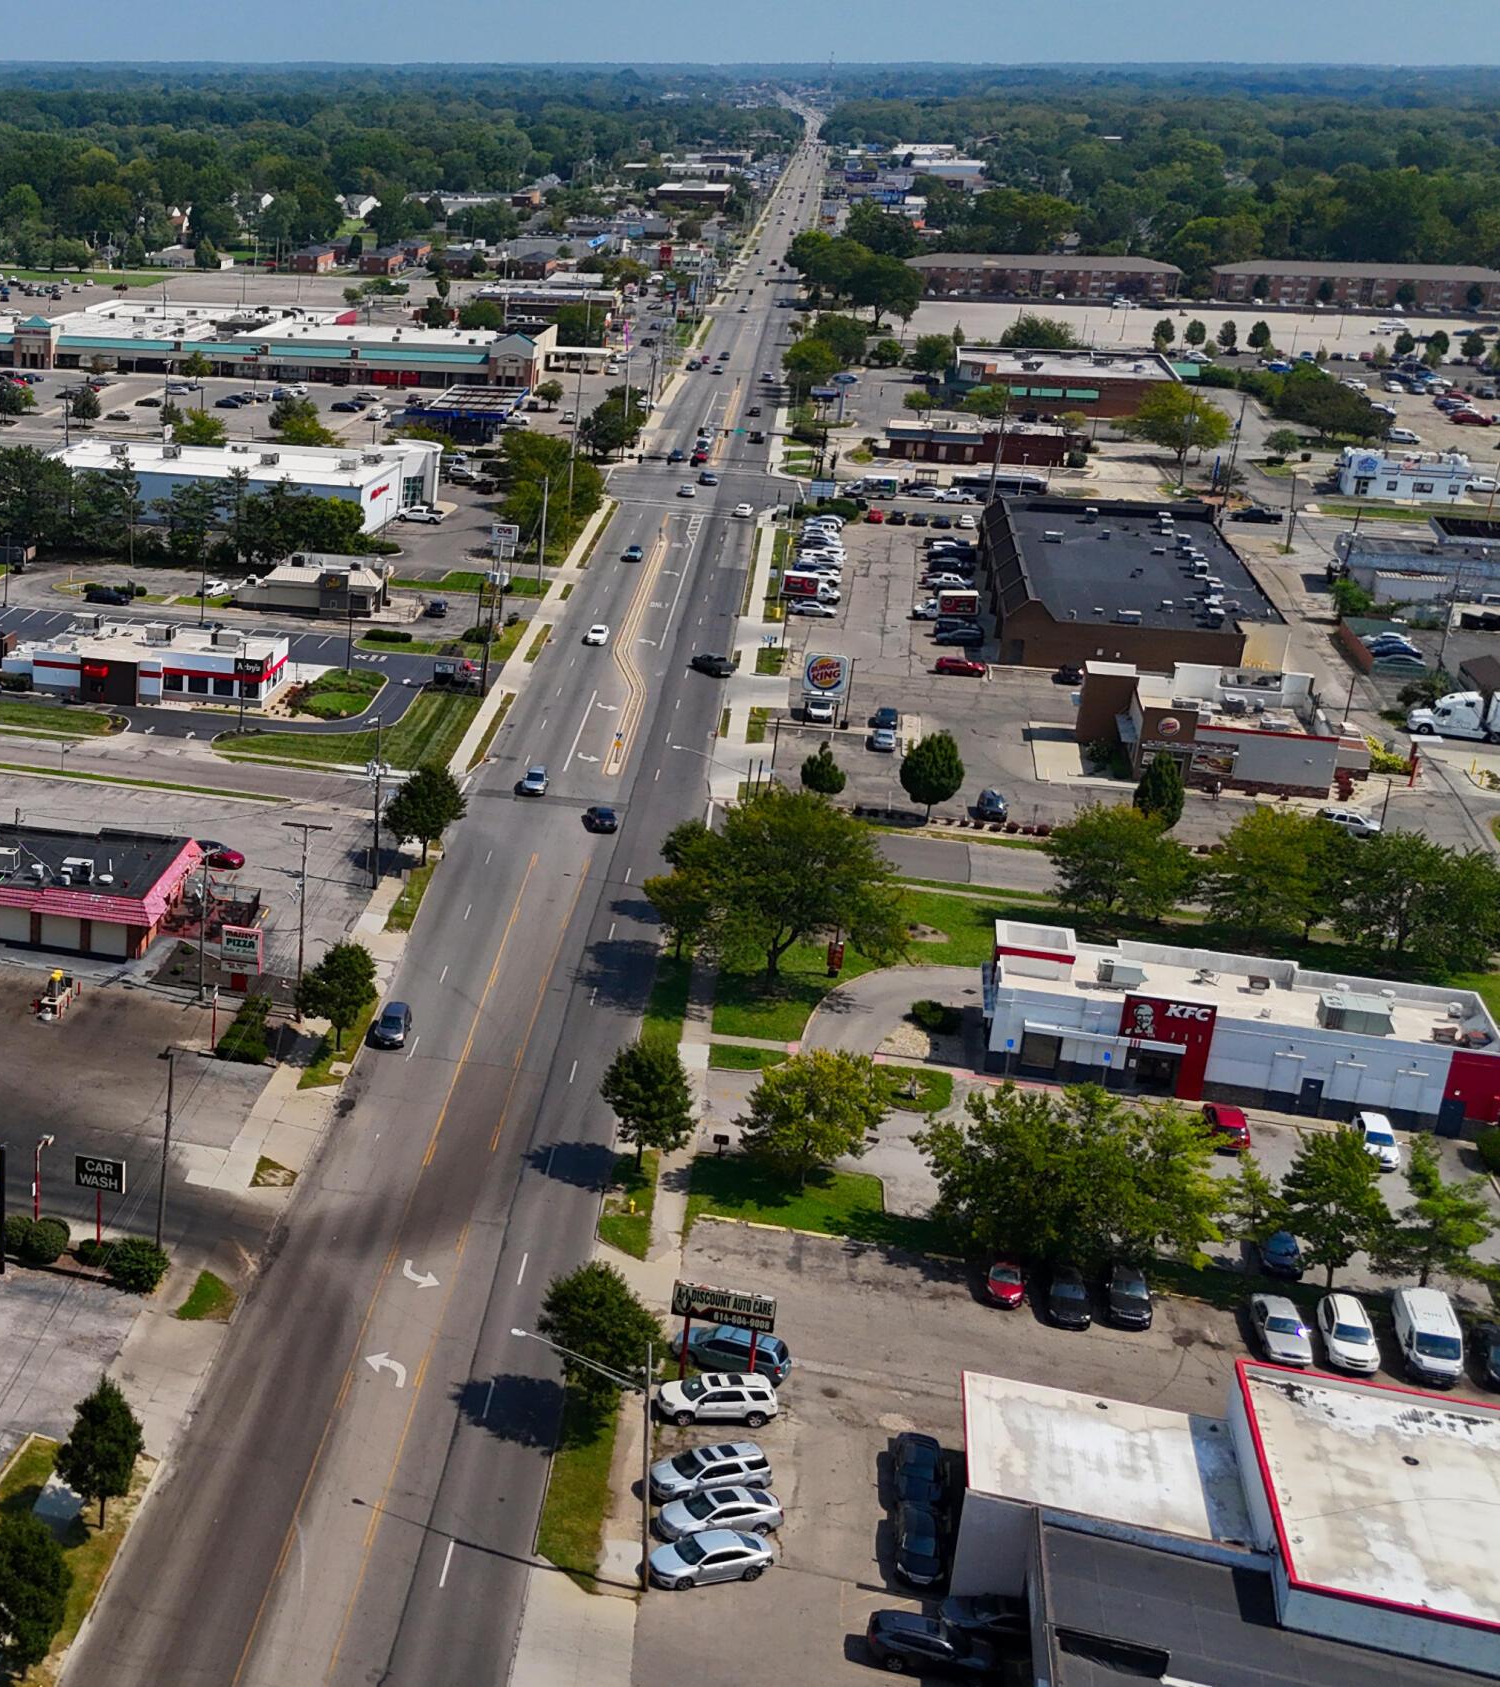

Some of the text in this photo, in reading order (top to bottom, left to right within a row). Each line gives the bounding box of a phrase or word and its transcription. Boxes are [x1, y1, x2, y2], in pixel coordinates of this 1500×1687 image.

[650, 601, 669, 609] ONLY
[811, 661, 841, 673] BURGER
[812, 670, 841, 682] KING
[226, 938, 255, 949] PIZZA
[1165, 1004, 1212, 1022] KFC
[84, 1160, 114, 1175] CAR
[79, 1172, 119, 1190] WASH
[690, 1289, 732, 1309] DISCOUNT
[732, 1296, 753, 1312] AUTO
[752, 1300, 774, 1316] CARE
